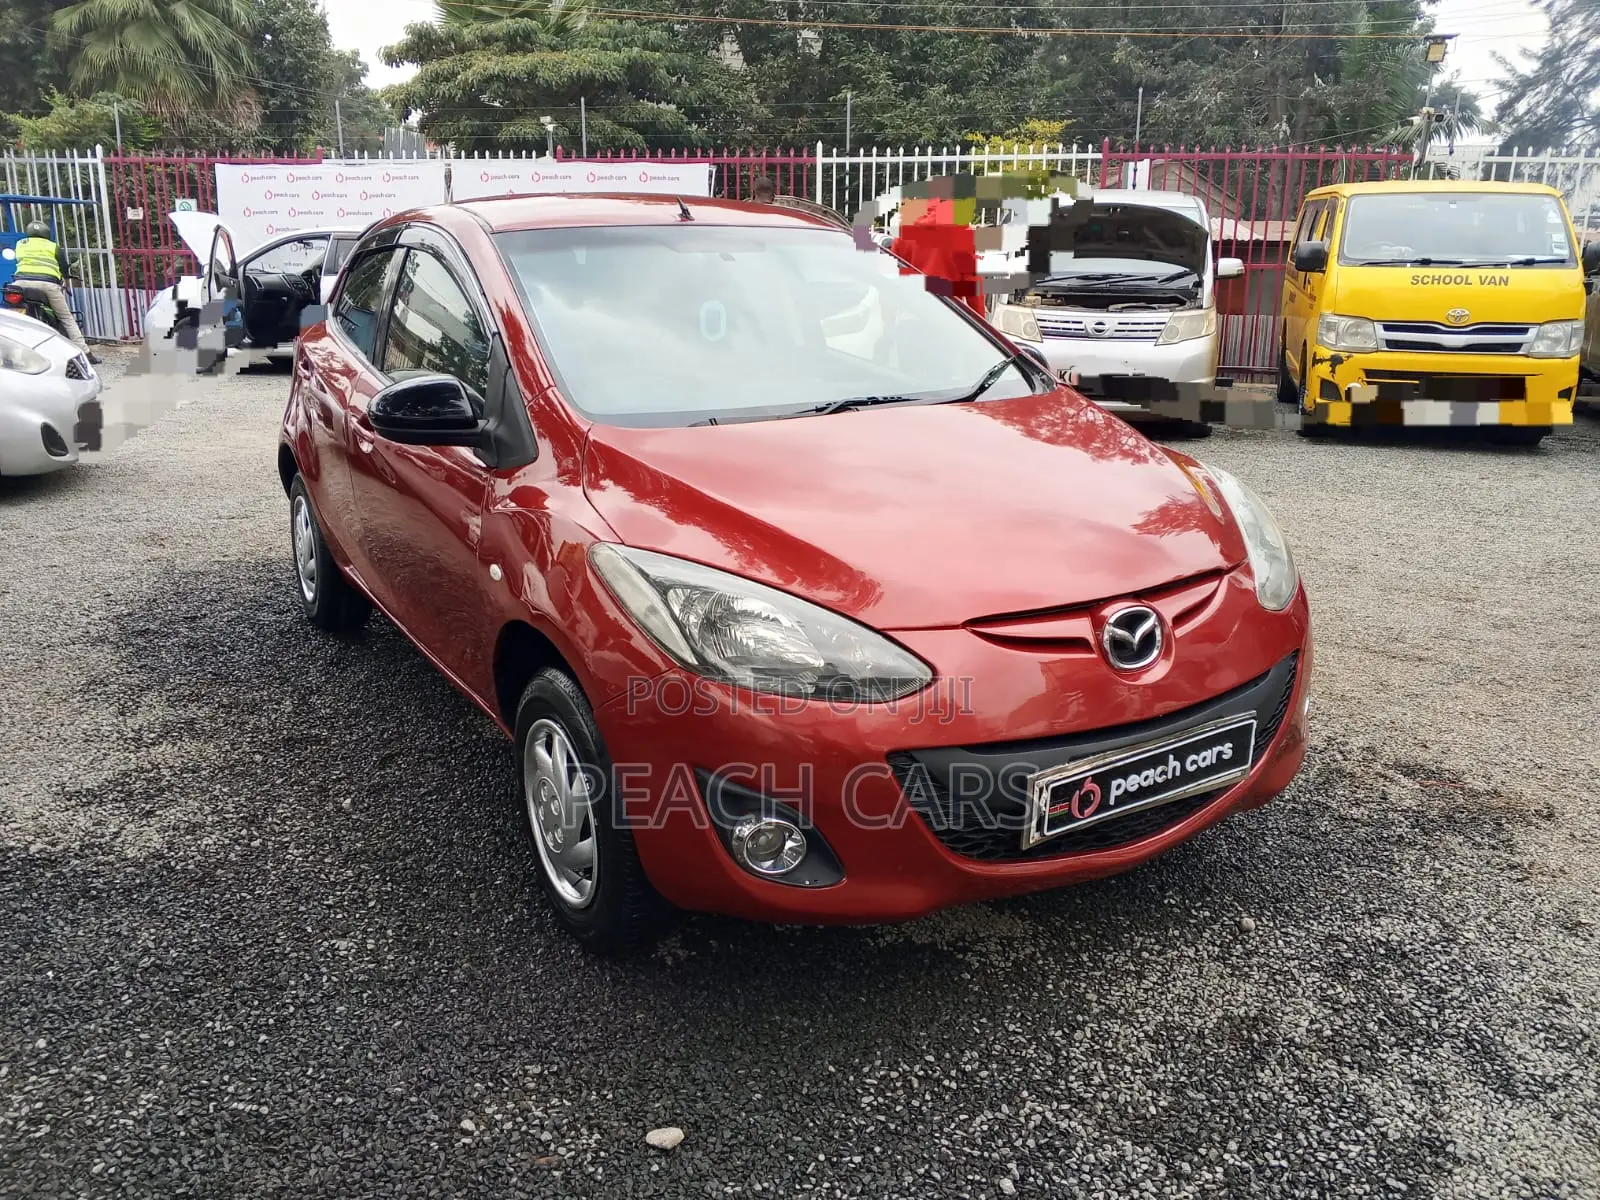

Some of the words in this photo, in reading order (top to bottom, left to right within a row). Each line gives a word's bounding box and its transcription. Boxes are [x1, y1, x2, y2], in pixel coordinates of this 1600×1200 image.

[273, 191, 288, 199] peach
[1410, 274, 1473, 286] SCHOOL
[1478, 275, 1510, 286] VAN
[1108, 754, 1181, 806] peach
[1185, 742, 1234, 772] cars
